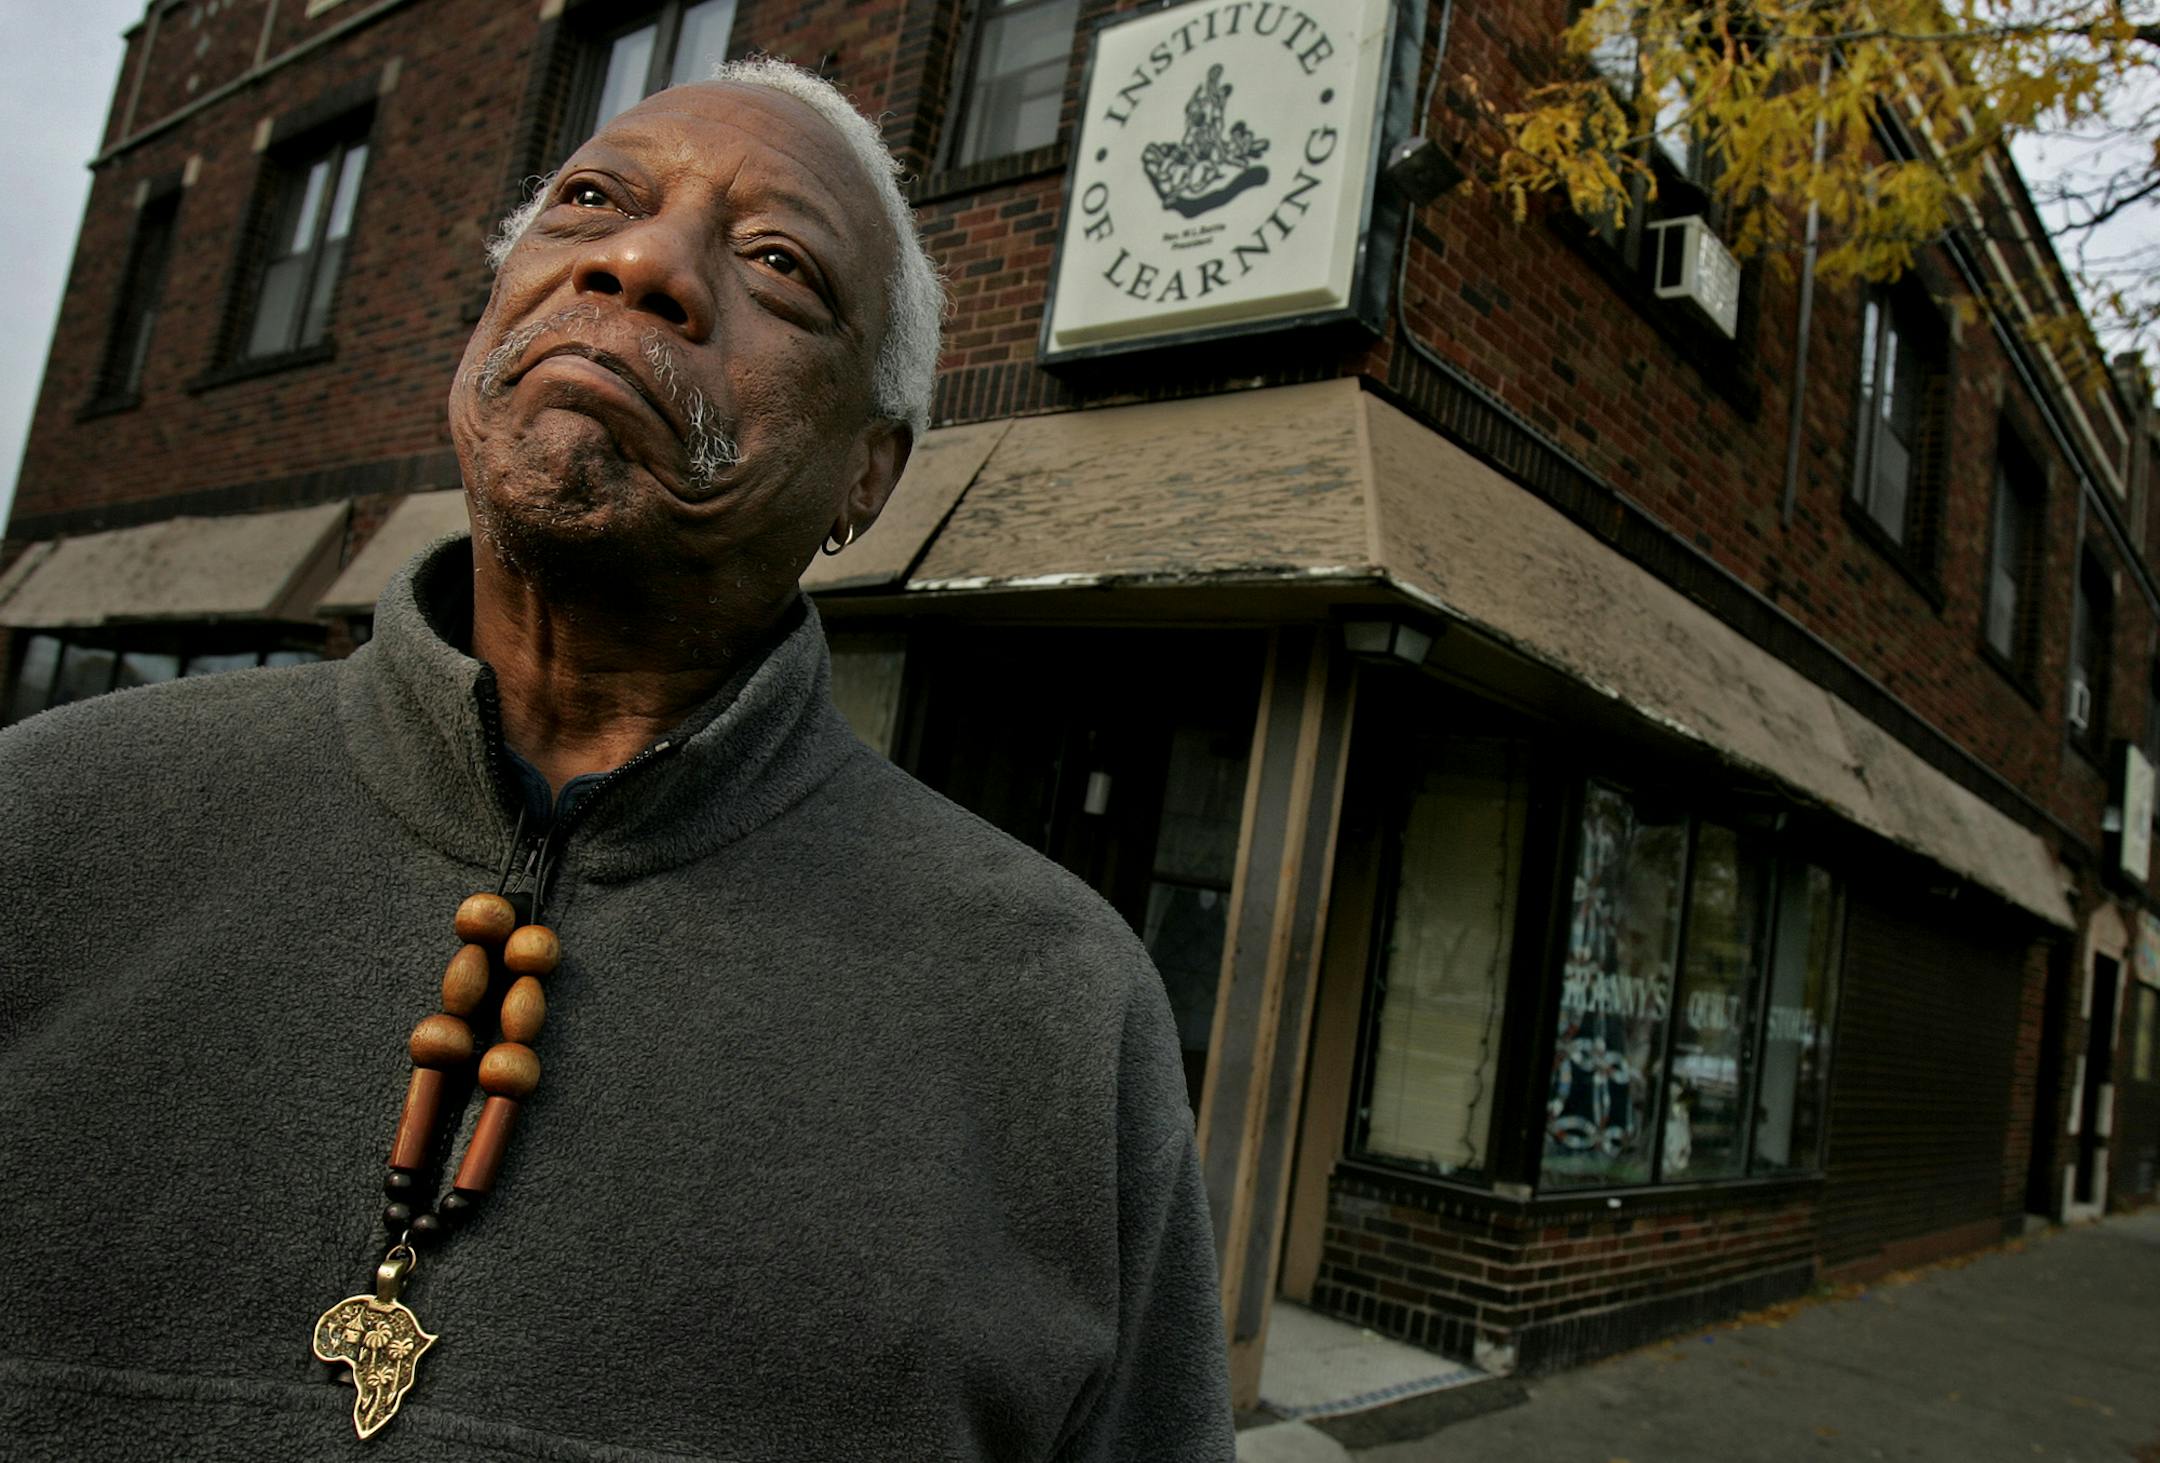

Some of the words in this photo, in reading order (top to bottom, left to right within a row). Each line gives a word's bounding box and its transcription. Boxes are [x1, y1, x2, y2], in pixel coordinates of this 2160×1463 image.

[1103, 2, 1335, 128] INSTITUTE
[1081, 181, 1114, 242] OF
[1102, 124, 1338, 303] LEARNING
[1687, 990, 1740, 1031] QUILT
